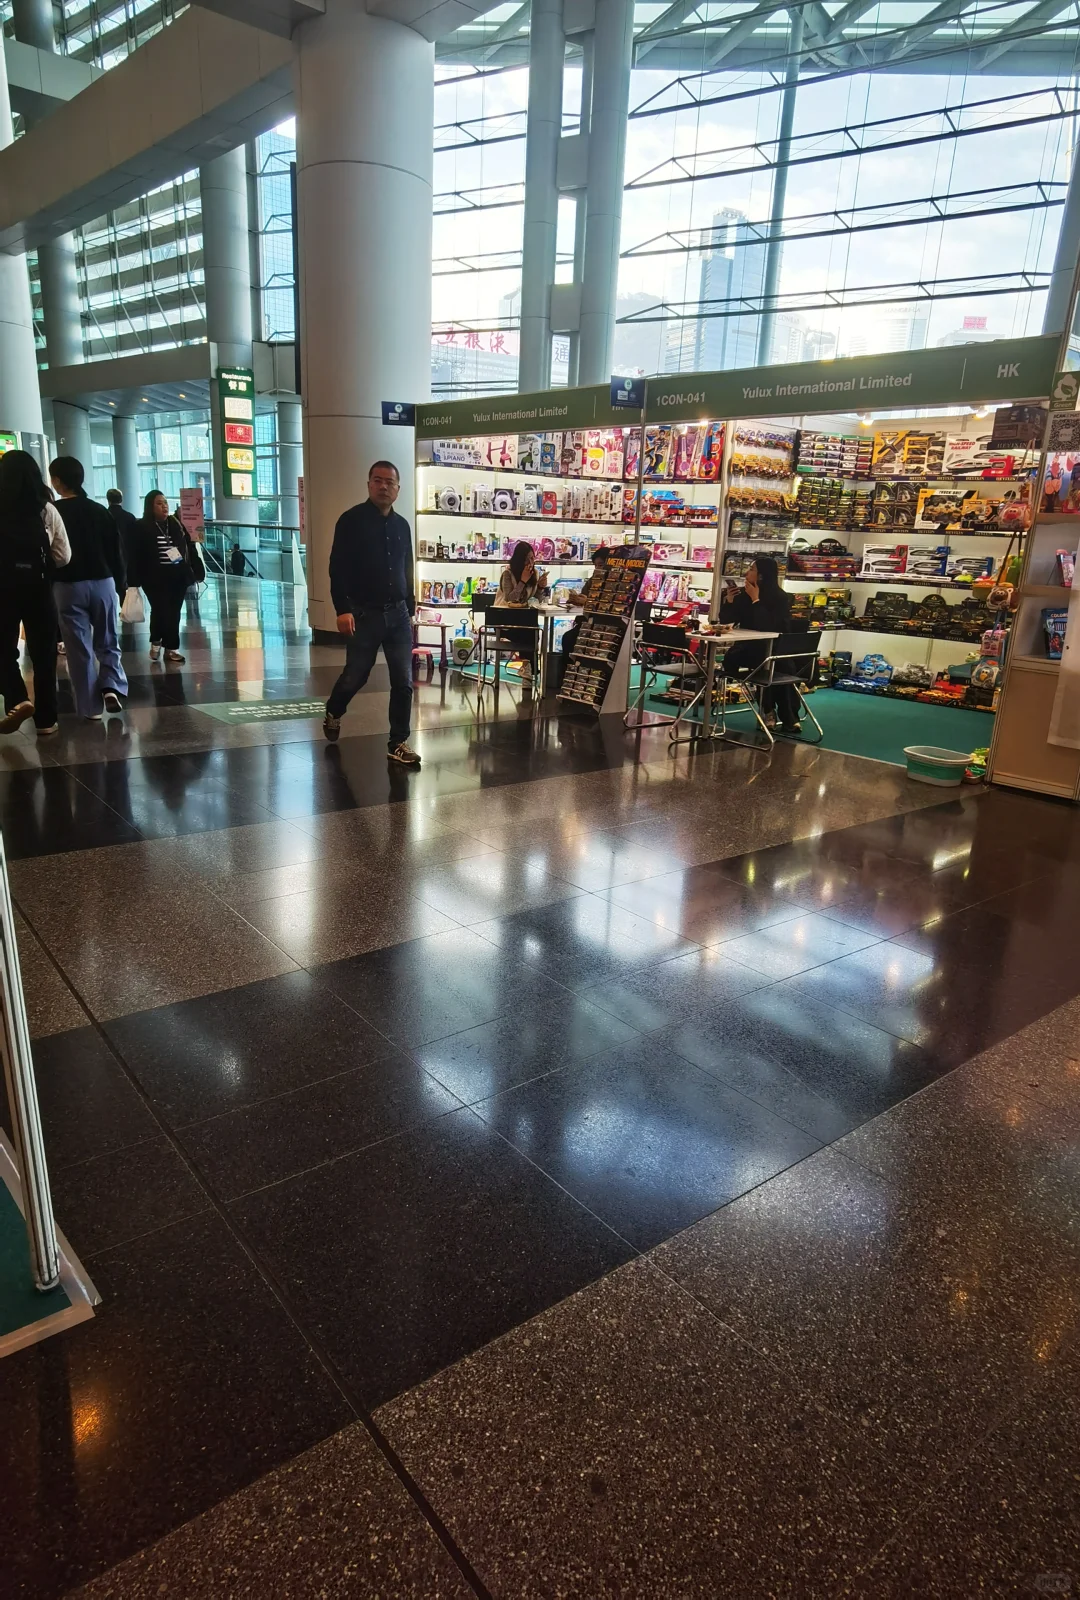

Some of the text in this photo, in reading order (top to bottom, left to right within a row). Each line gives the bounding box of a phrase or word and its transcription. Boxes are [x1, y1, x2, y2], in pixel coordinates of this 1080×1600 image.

[656, 392, 706, 407] 1CON-041
[742, 387, 772, 399] Yulux
[775, 378, 855, 397] International
[859, 373, 912, 390] Limited
[996, 362, 1021, 379] HK
[422, 405, 568, 426] 1CON-041 Yulux International Limited
[607, 558, 645, 568] METAL MODEL
